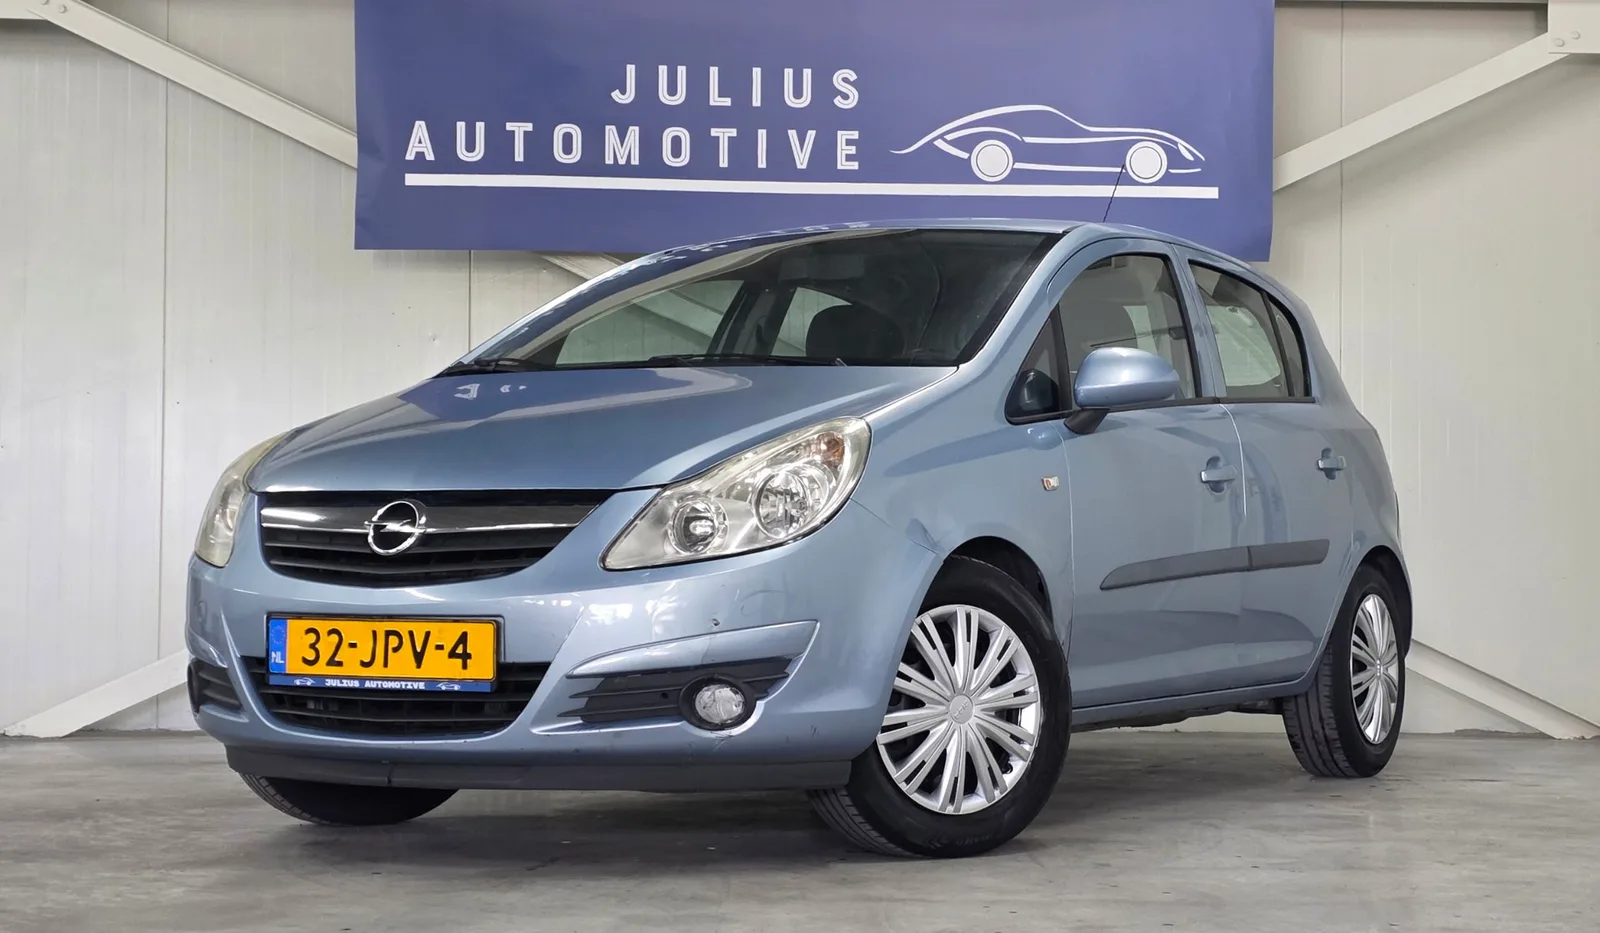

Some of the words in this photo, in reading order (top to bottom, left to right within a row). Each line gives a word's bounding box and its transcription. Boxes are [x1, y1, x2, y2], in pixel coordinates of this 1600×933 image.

[610, 63, 860, 109] JULIUS
[405, 120, 860, 170] AUTOMOTIVE
[271, 651, 284, 664] NL
[301, 627, 472, 670] 32-JPV-4
[325, 678, 359, 688] JULIUS
[364, 680, 425, 690] AUTOMOTIVE
